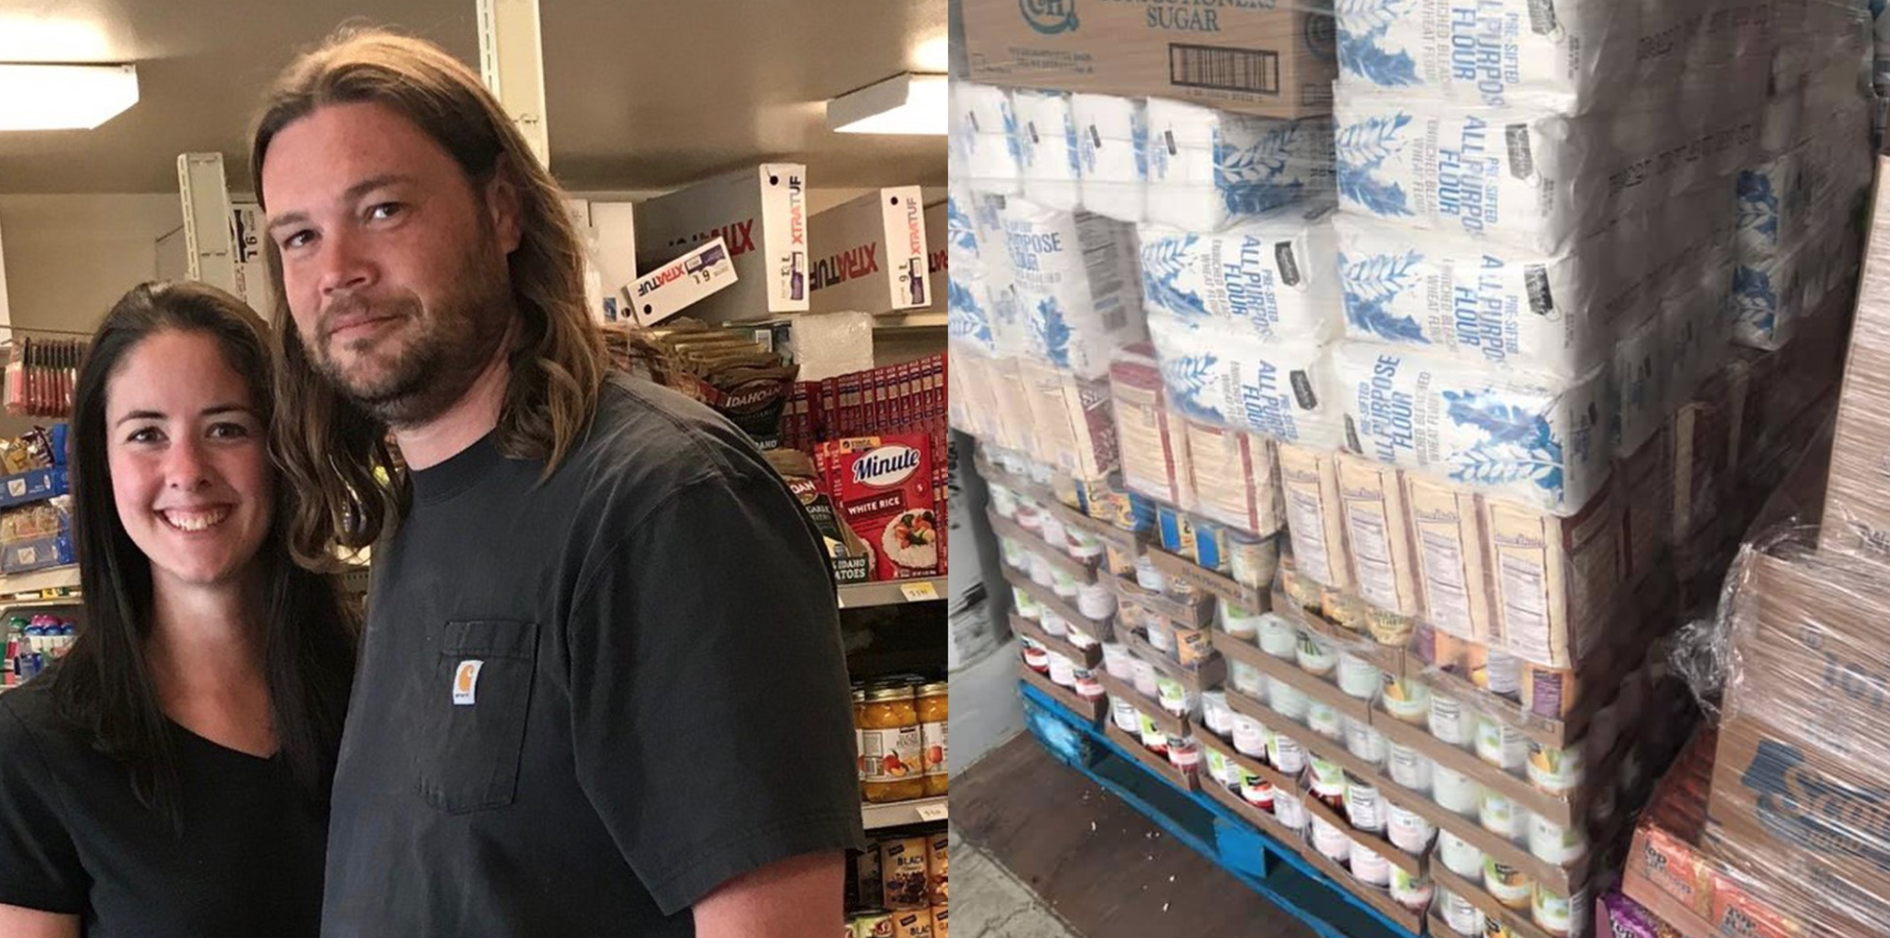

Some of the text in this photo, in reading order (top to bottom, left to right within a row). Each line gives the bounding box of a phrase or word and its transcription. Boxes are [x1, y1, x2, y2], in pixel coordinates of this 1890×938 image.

[1146, 5, 1221, 31] SUGAR
[1451, 7, 1477, 80] FLOUR
[1476, 17, 1506, 108] PURPOS
[1461, 114, 1488, 154] ALL
[1437, 148, 1461, 215] FLOUR
[790, 175, 804, 246] XTRATUF
[907, 198, 921, 255] XTRATUF
[1241, 234, 1262, 268] ALL
[638, 262, 686, 297] XTRATUF
[1223, 263, 1248, 315] FLOUR
[1454, 286, 1480, 347] FLOUR
[1258, 359, 1276, 392] ALL
[1370, 354, 1401, 439] PURPOSE
[1390, 391, 1414, 449] FLOUR
[853, 448, 921, 481] Minute
[847, 496, 901, 515] WHITE RICE
